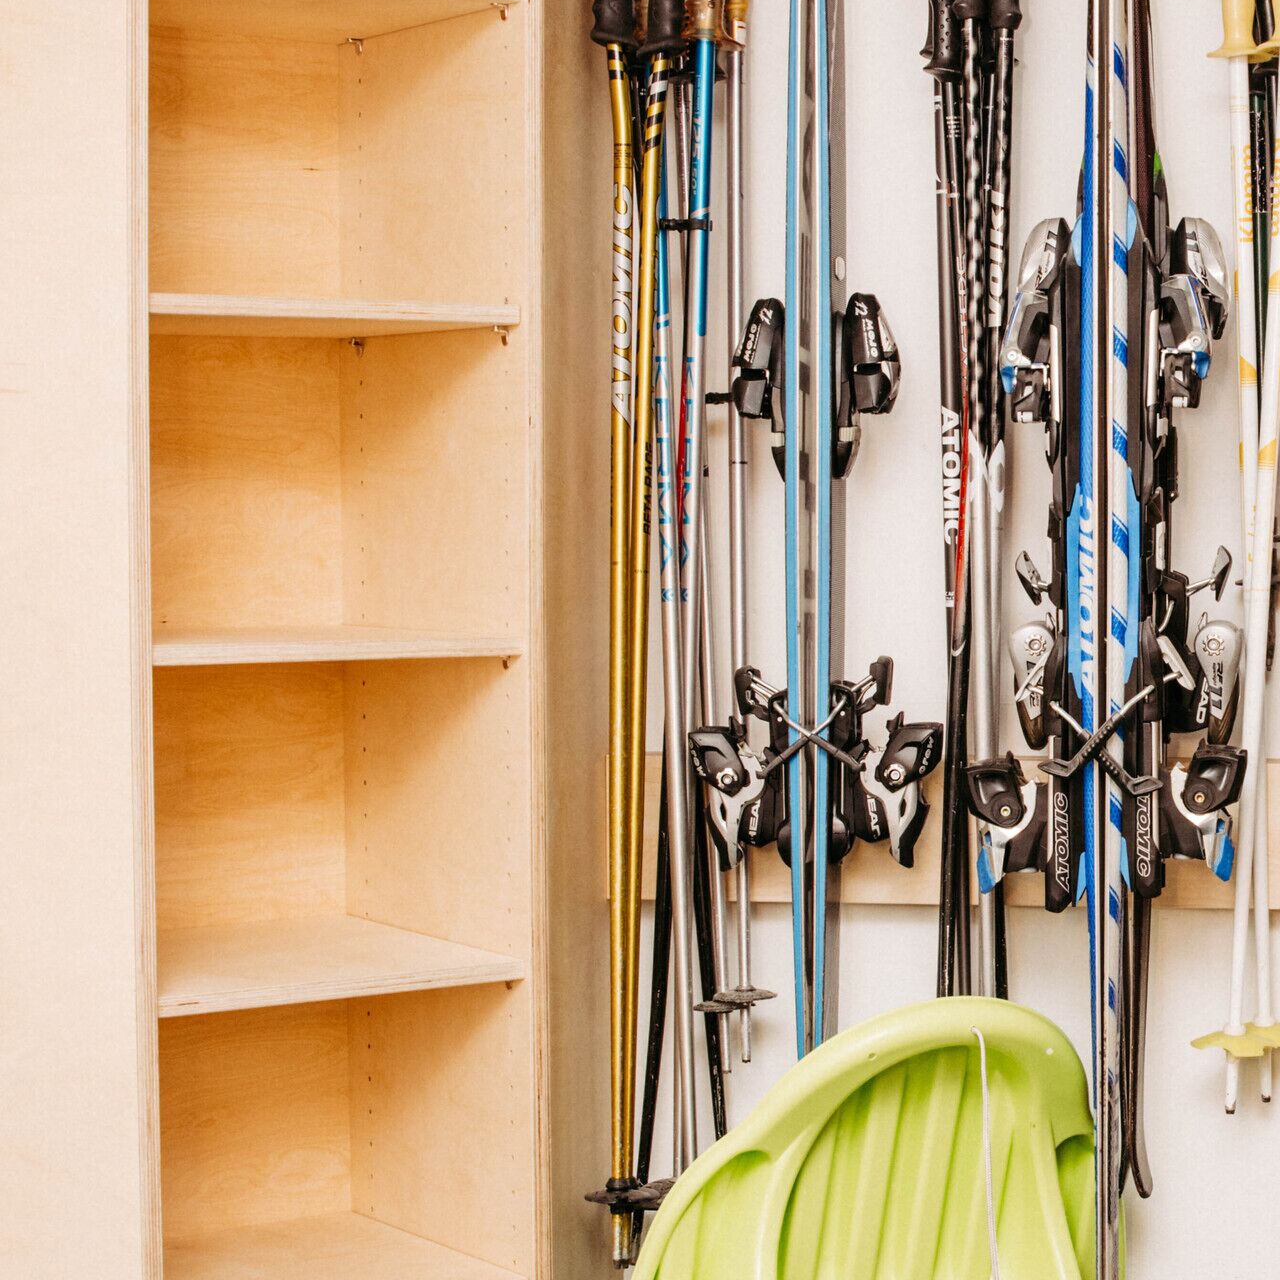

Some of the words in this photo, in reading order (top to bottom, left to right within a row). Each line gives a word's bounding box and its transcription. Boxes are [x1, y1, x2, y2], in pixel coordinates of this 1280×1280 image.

[612, 183, 632, 427] ATOMIC
[655, 356, 674, 576] KERMA
[941, 406, 961, 545] ATOMIC
[1079, 494, 1094, 701] ATOMIC
[1196, 677, 1209, 724] EAD
[1054, 791, 1069, 893] ATOMIC
[1136, 794, 1151, 878] TOMIC
